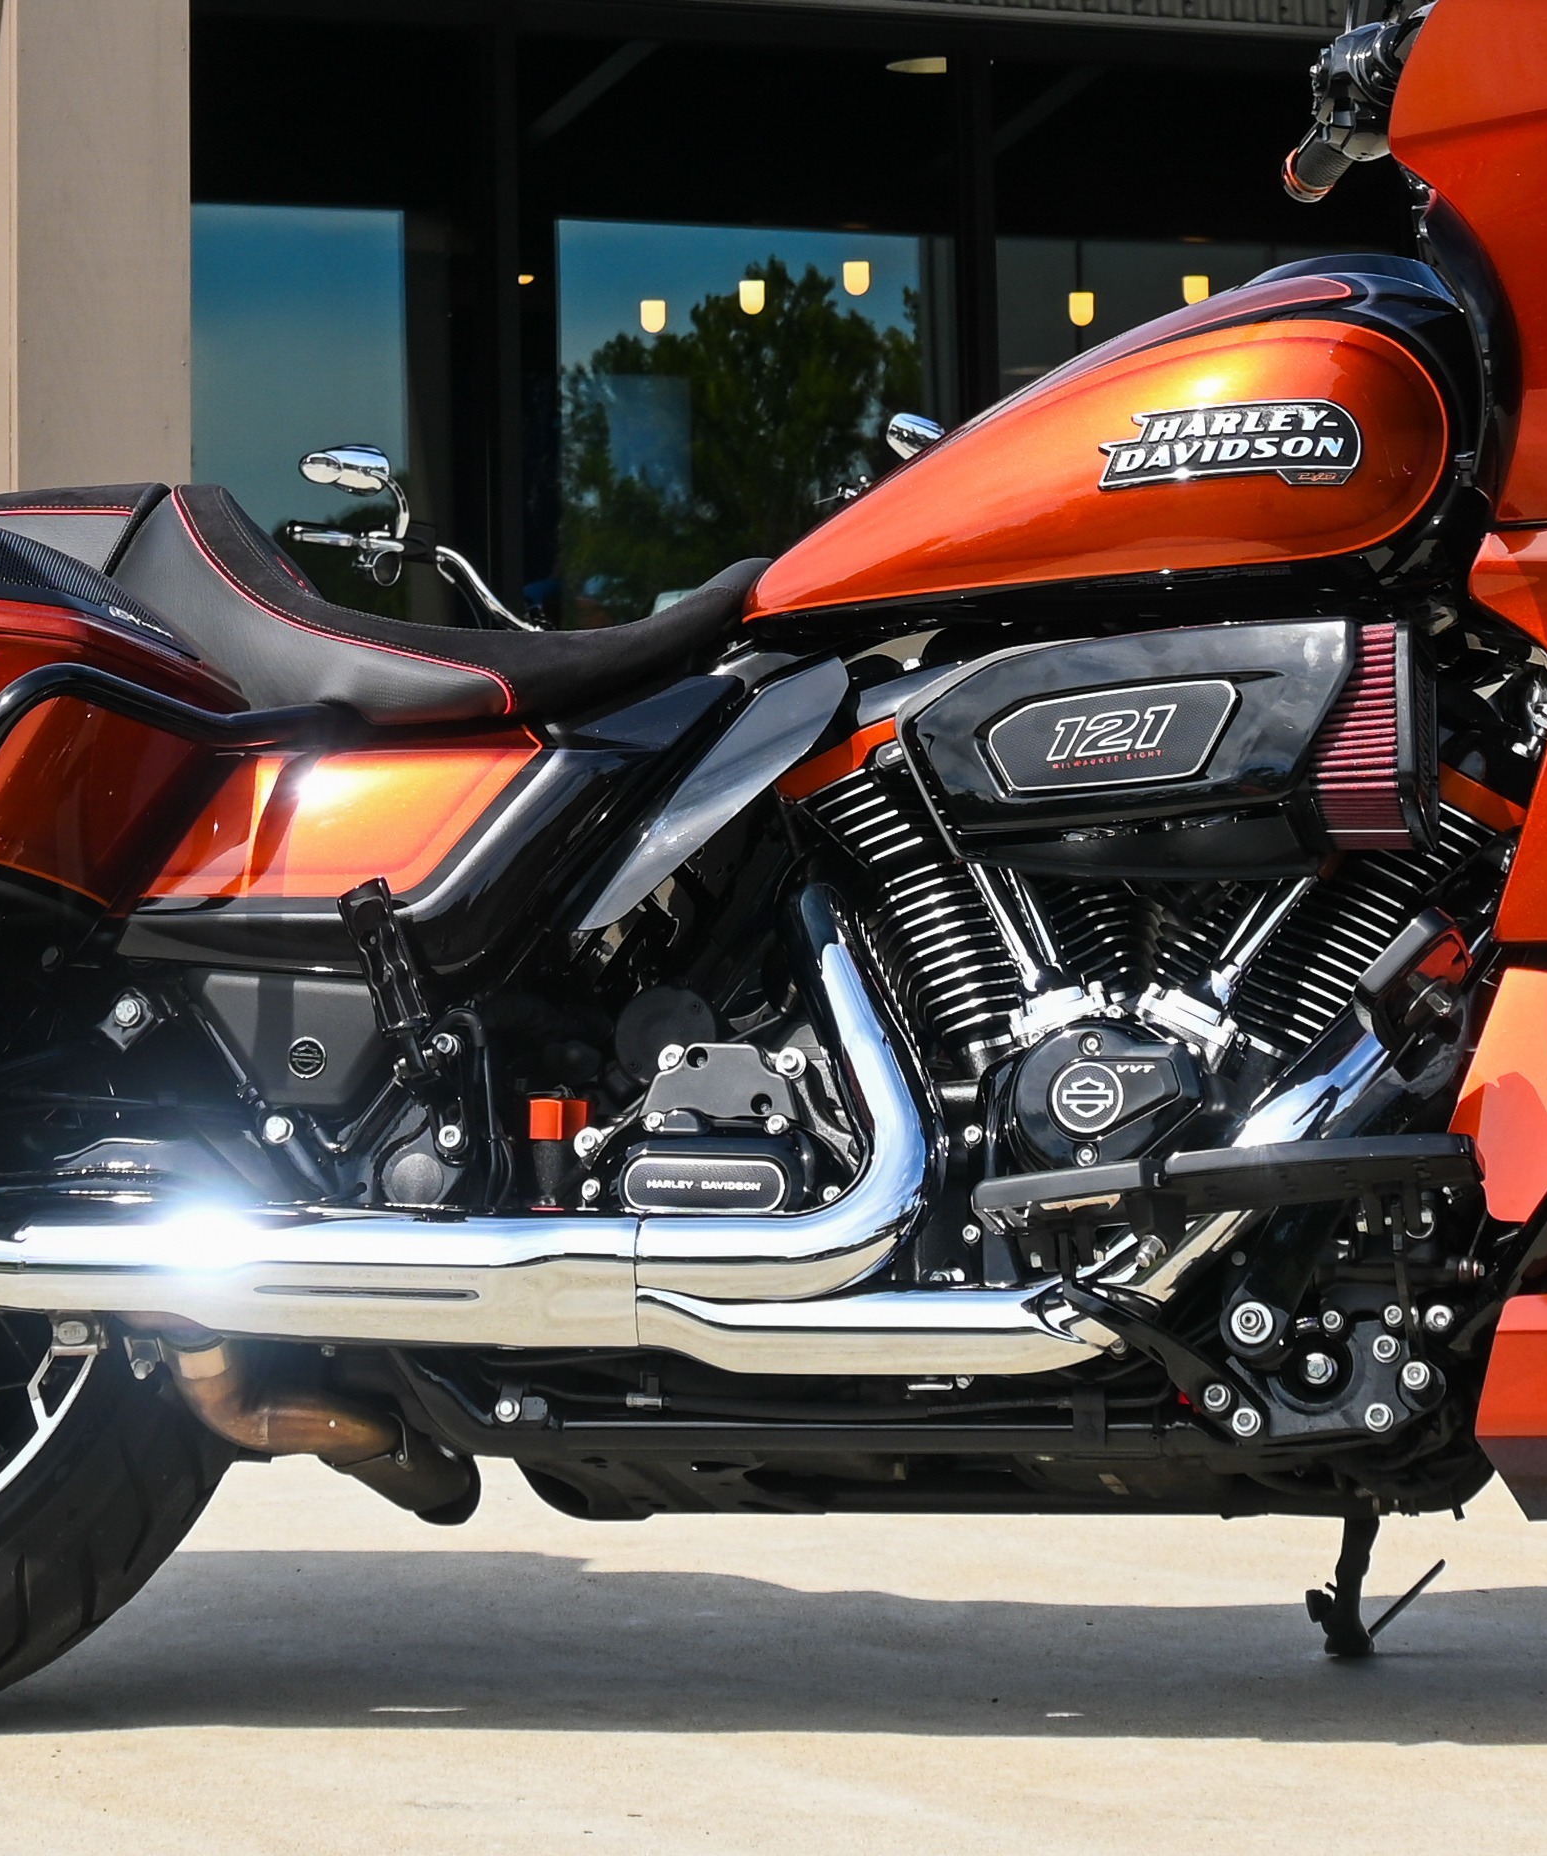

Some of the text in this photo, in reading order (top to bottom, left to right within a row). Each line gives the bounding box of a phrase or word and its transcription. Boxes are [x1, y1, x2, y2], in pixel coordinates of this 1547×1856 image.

[1146, 409, 1339, 444] HARLEY-
[1114, 436, 1344, 474] DAVIDSON
[1045, 703, 1178, 762] 121
[1115, 1064, 1156, 1074] VVT
